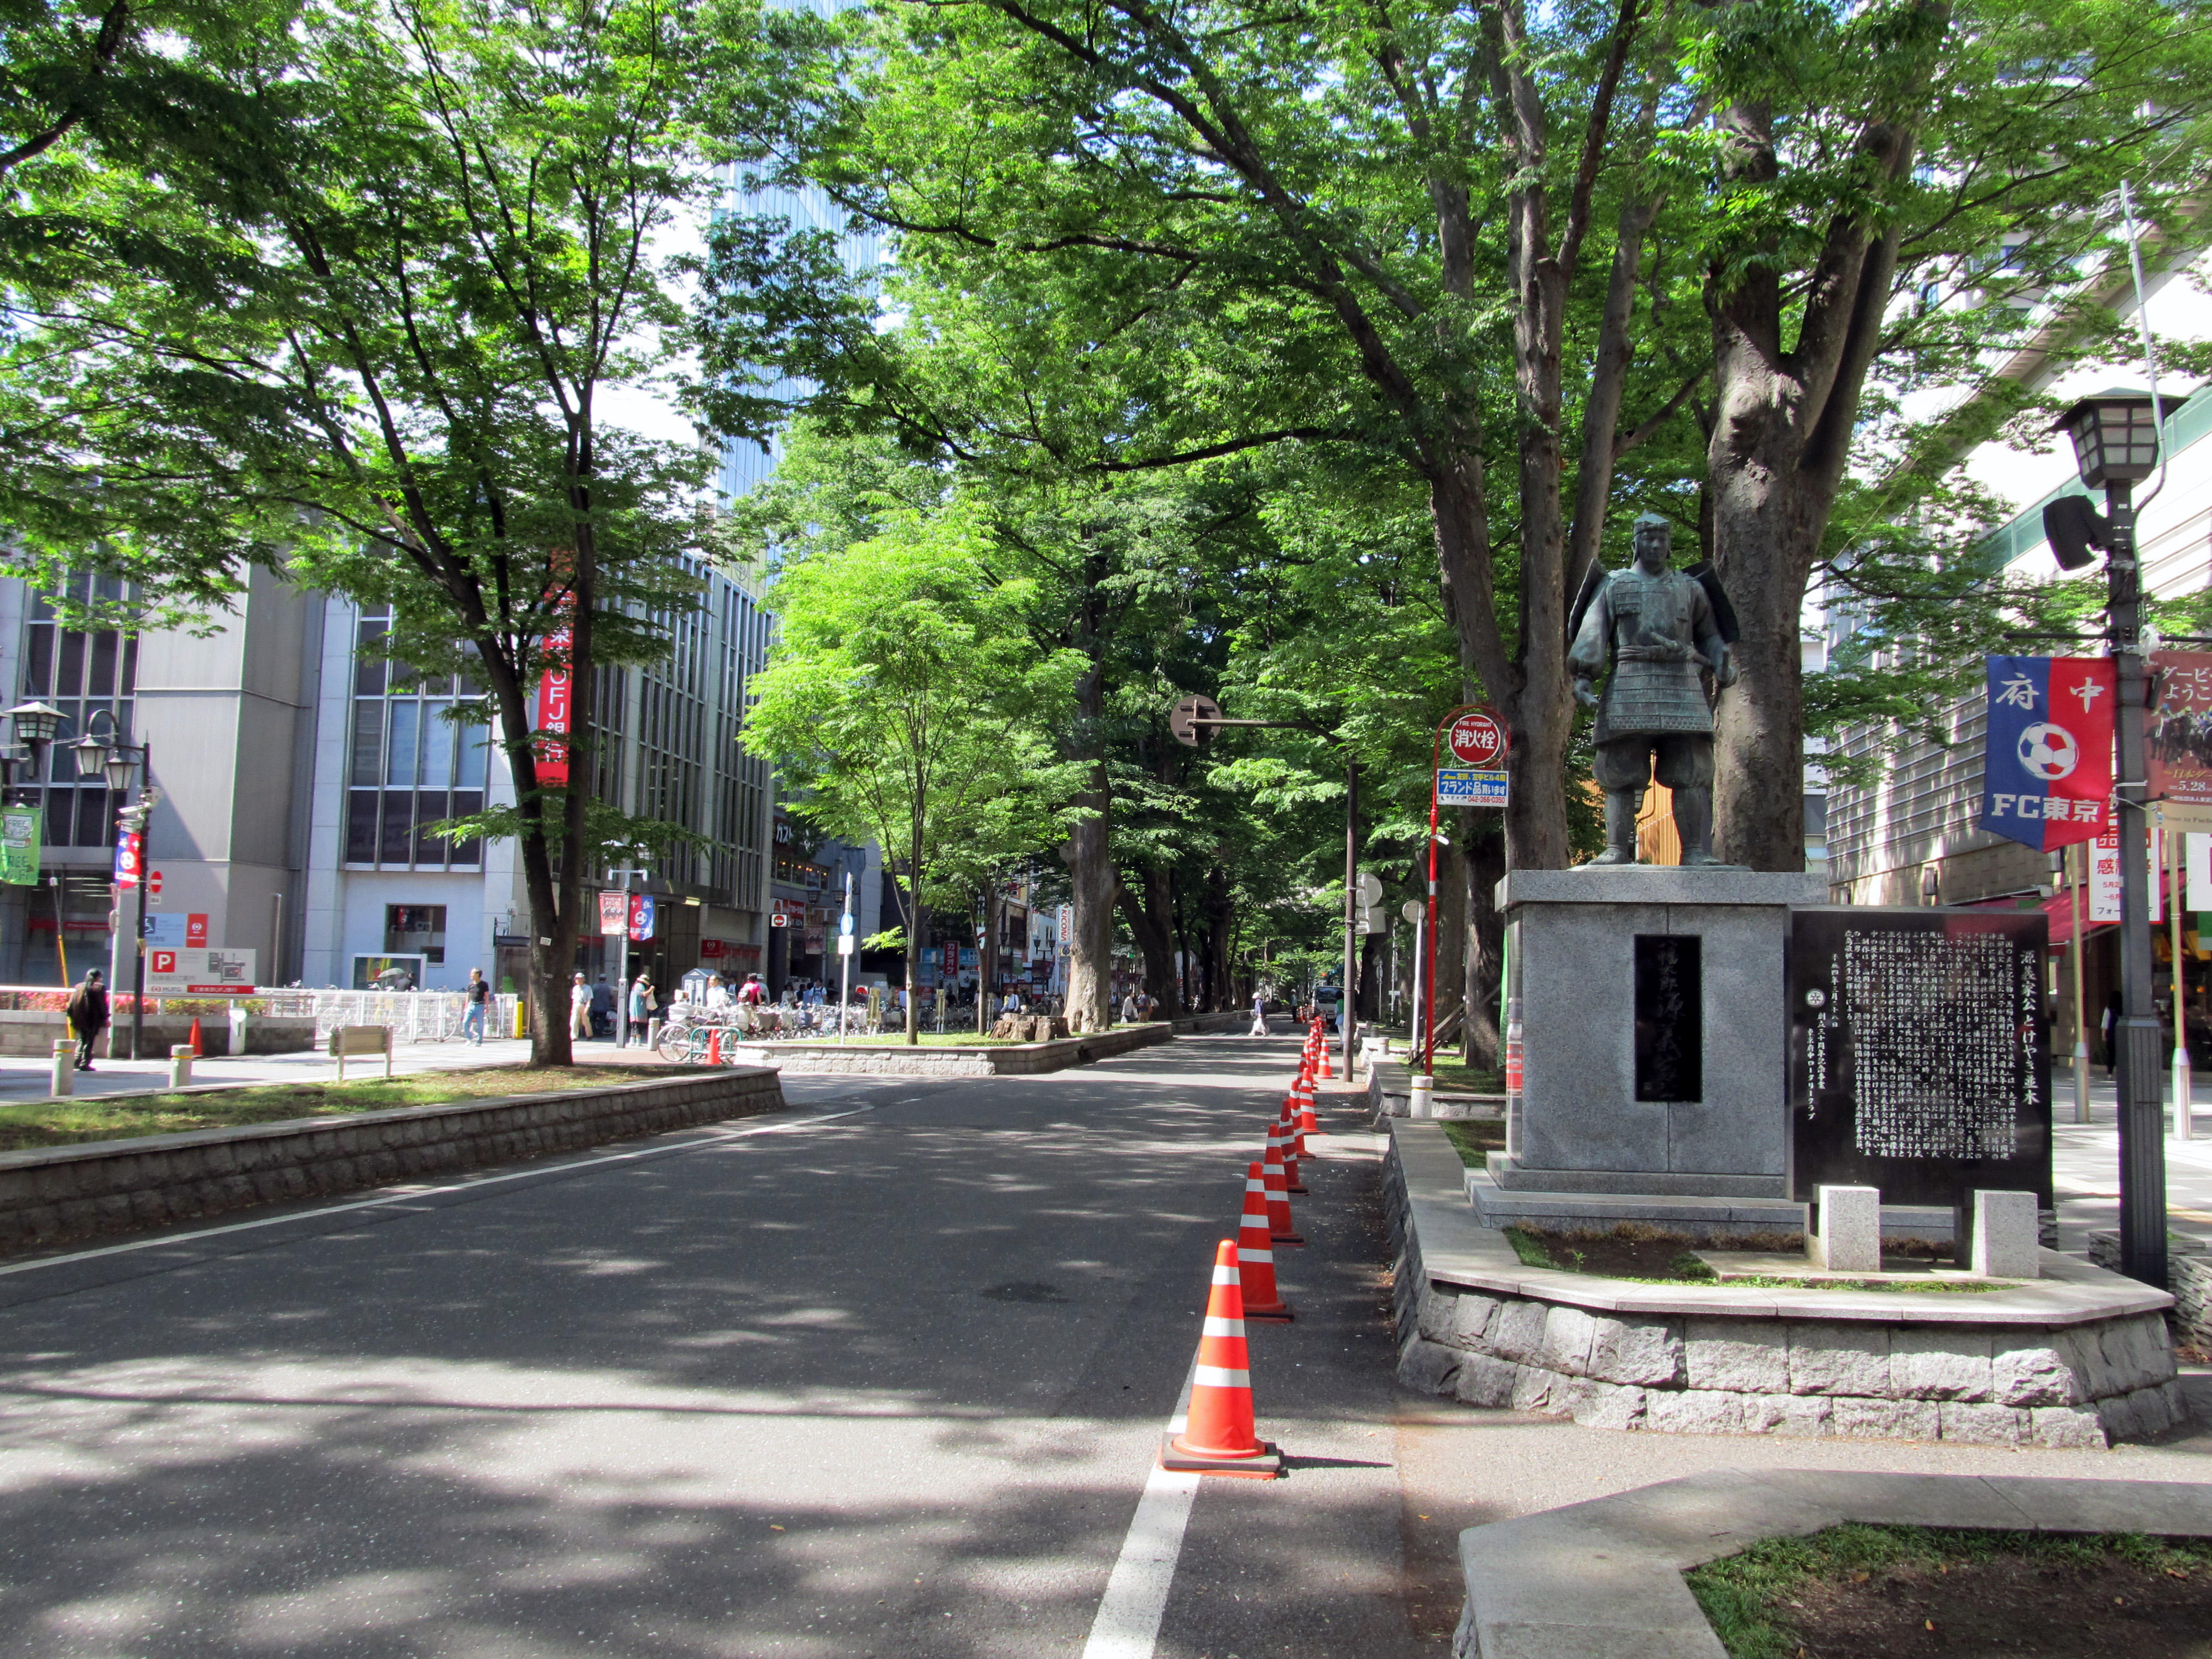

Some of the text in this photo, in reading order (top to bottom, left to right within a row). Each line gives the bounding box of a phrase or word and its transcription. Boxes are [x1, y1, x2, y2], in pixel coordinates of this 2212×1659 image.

[2162, 666, 2212, 680] ダービ
[1996, 672, 2105, 713] 府 中
[2164, 684, 2212, 702] ようこ
[1454, 729, 1496, 749] 消火栓
[1441, 781, 1506, 795] ブランド品買います
[1991, 793, 2101, 823] FC東京
[158, 954, 171, 970] P
[947, 943, 955, 974] カラオケ
